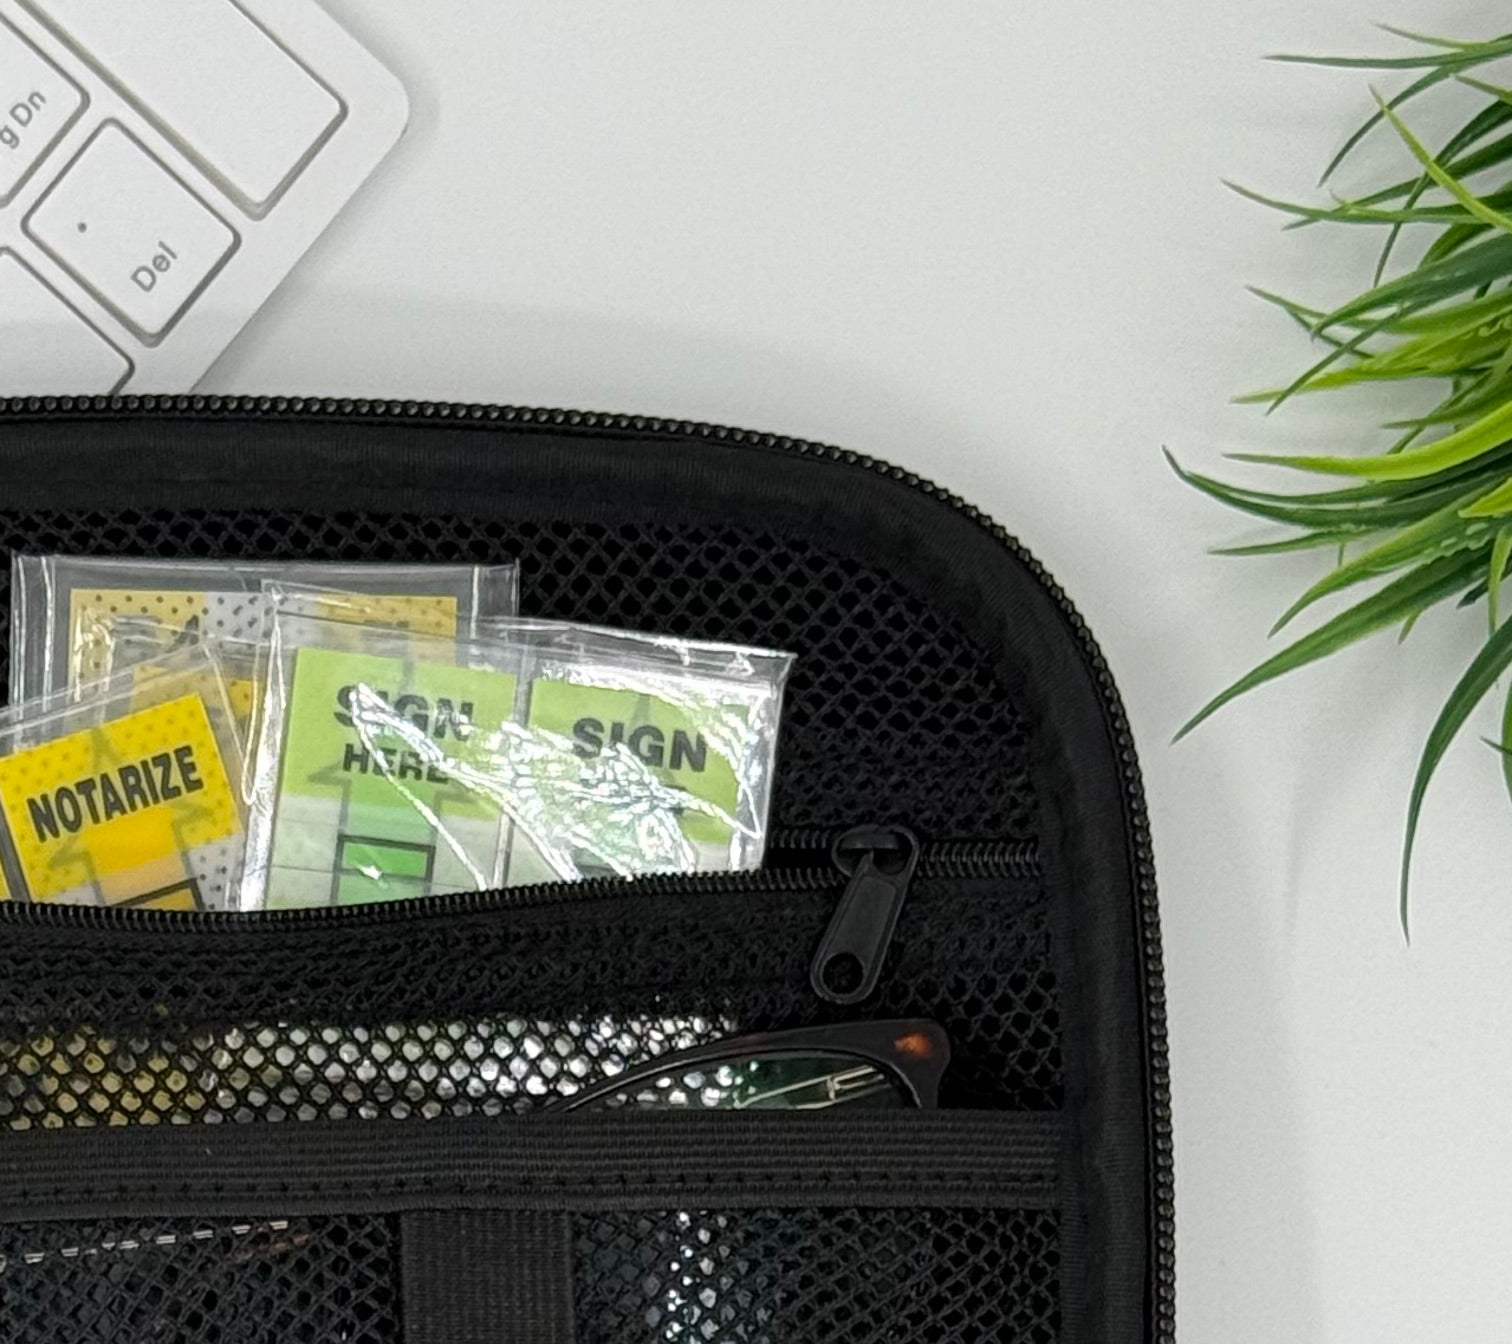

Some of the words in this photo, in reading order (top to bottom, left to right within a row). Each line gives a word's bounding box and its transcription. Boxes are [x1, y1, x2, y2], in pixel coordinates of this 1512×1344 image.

[8, 87, 47, 127] Dn
[131, 241, 177, 292] Del
[343, 743, 448, 785] HERE
[571, 716, 707, 775] SIGN
[26, 744, 205, 844] NOTARIZE
